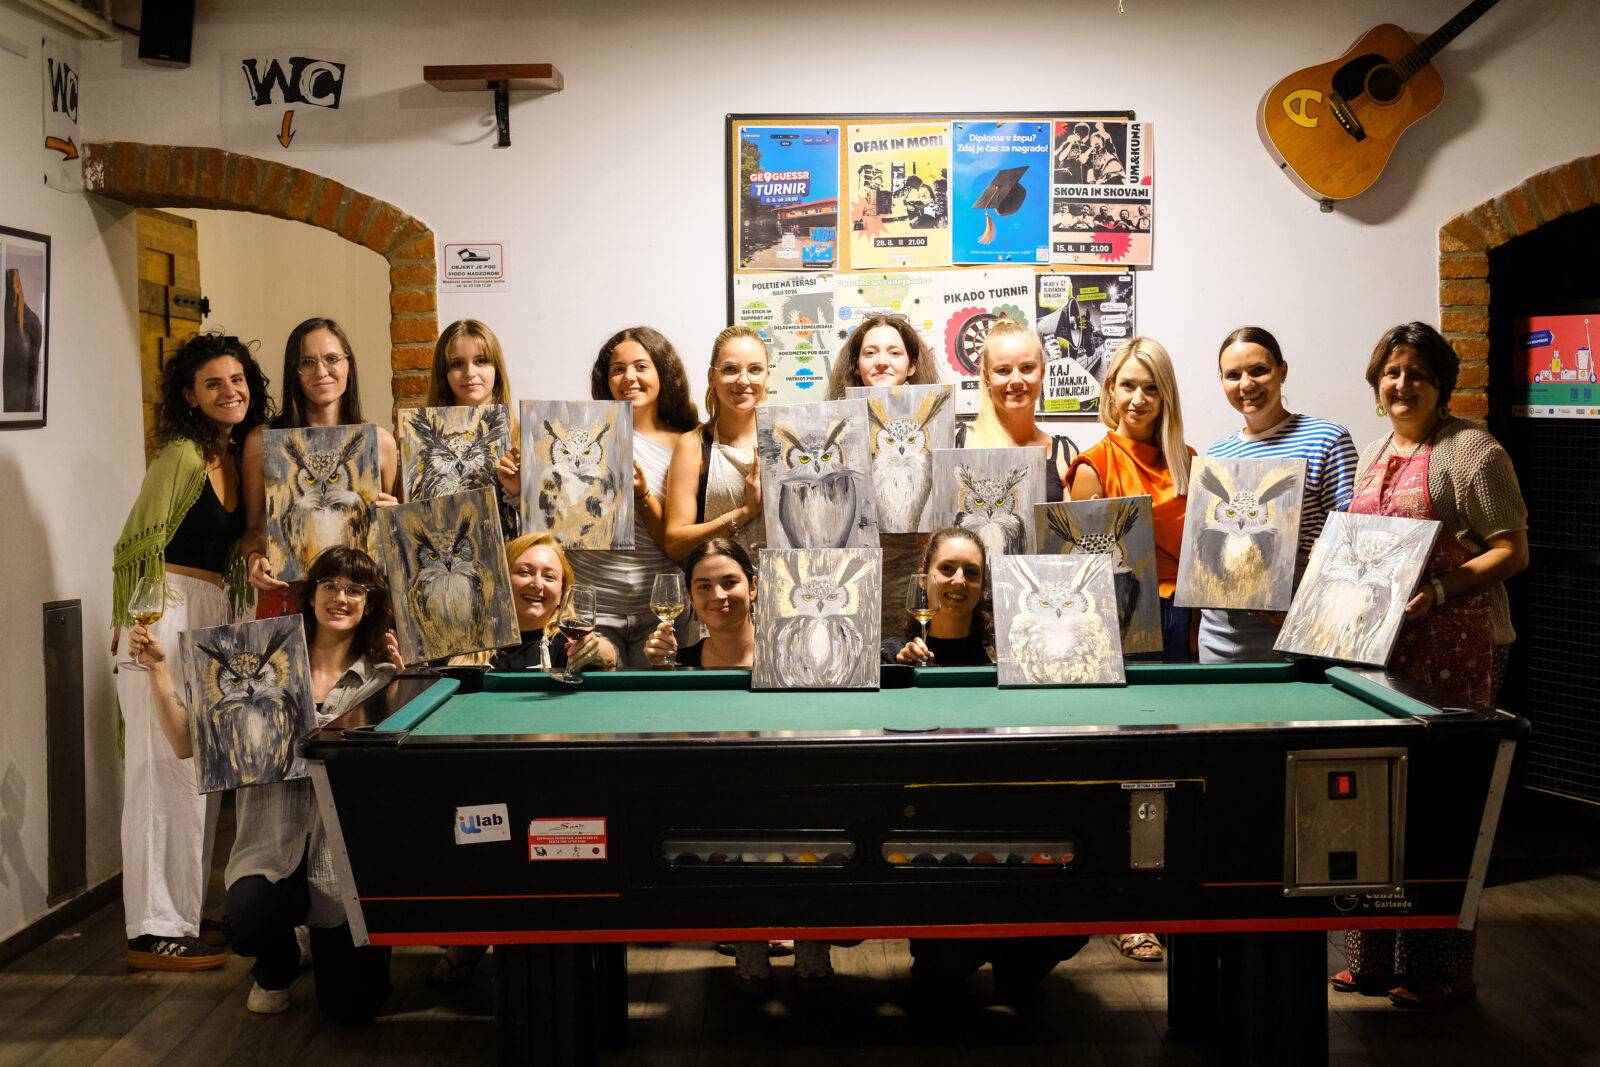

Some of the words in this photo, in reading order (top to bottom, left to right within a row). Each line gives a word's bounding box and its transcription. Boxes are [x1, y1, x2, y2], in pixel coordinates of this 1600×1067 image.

[242, 57, 345, 109] WC
[48, 58, 78, 124] WC
[853, 139, 889, 153] OFAK
[891, 138, 905, 149] IN
[907, 135, 943, 148] MORI
[969, 134, 1005, 143] Diploma
[1012, 134, 1036, 143] žepu?
[957, 145, 976, 153] Zdaj
[976, 145, 984, 153] je
[985, 144, 999, 152] čas
[1011, 144, 1048, 153] nagrado!
[1130, 123, 1141, 184] UM&KUNA
[755, 182, 806, 196] TURNIR
[1054, 187, 1088, 196] SKOVA
[1091, 188, 1101, 196] IN
[1103, 188, 1148, 197] SKOVANI
[908, 238, 925, 246] 21.00
[1056, 244, 1066, 252] 15.
[1067, 244, 1075, 252] 8.
[1090, 244, 1110, 252] 21.00
[752, 282, 779, 290] POLETJE
[791, 279, 816, 287] TERASI
[944, 290, 985, 304] PIKADO
[988, 285, 1029, 299] TURNIR
[1049, 364, 1070, 377] KAJ
[1050, 377, 1056, 387] TI
[1058, 376, 1088, 386] MANJKA
[1049, 387, 1055, 397] V
[1374, 900, 1412, 908] Garlando
